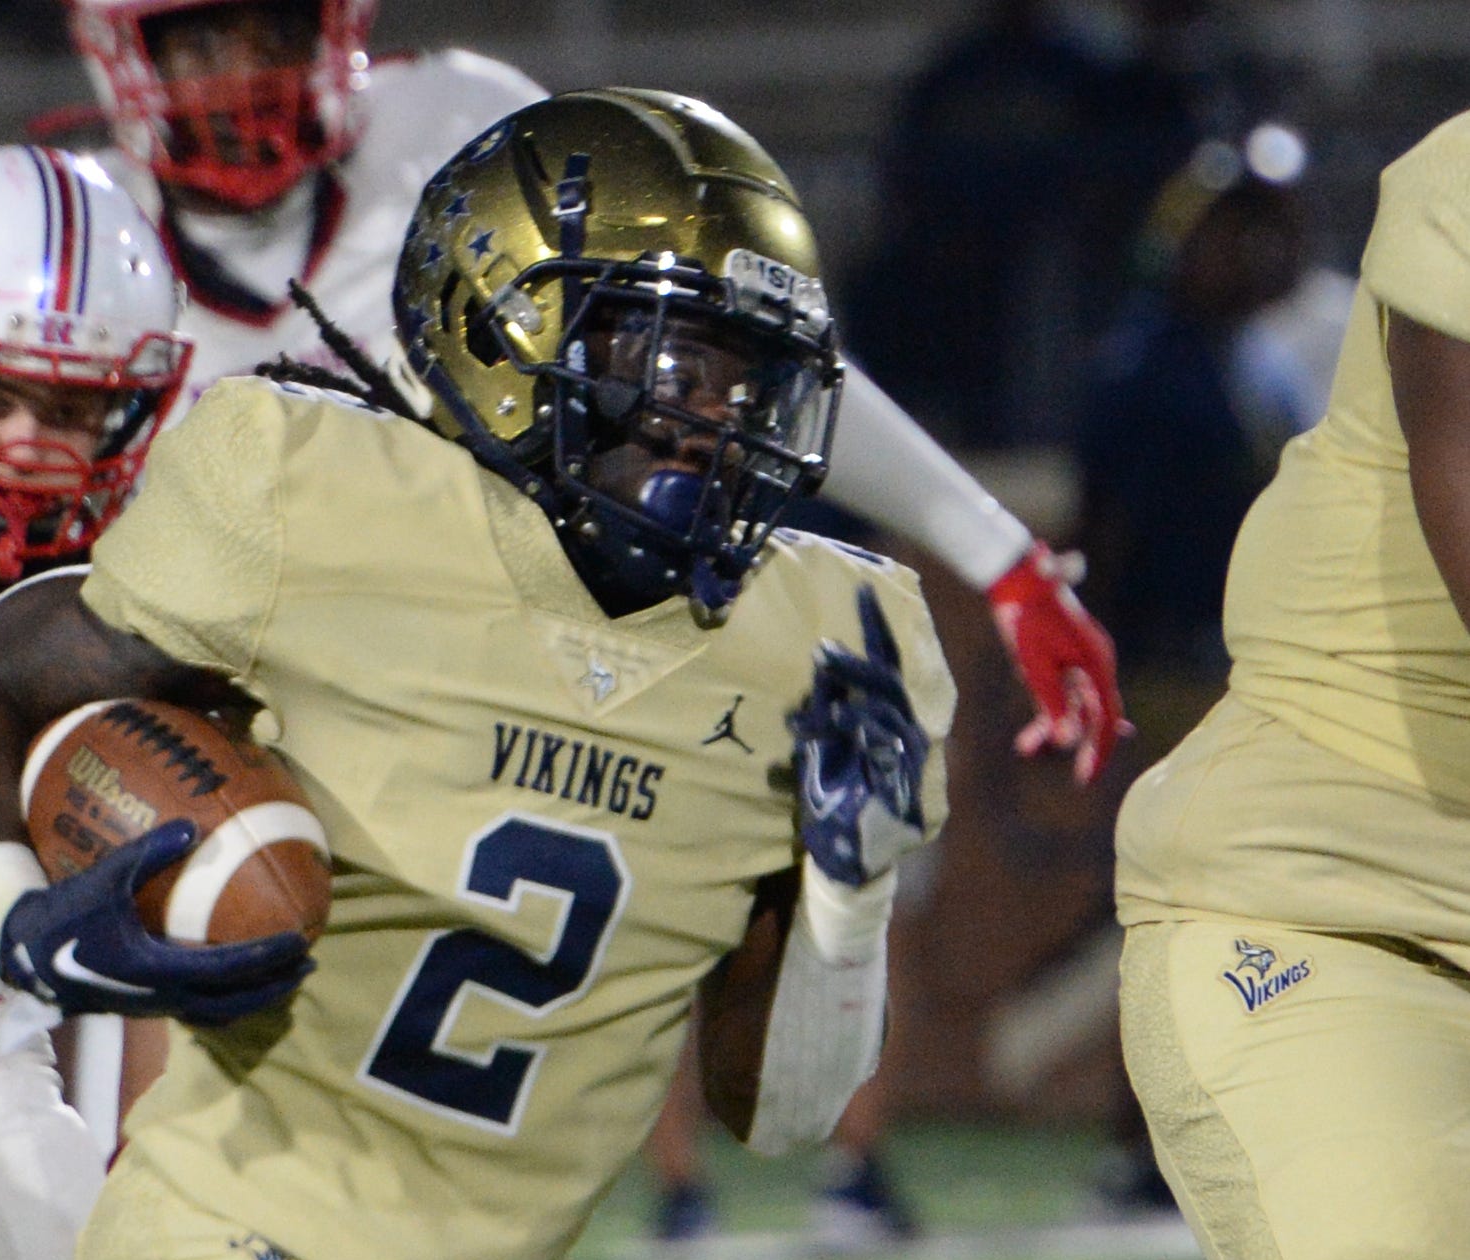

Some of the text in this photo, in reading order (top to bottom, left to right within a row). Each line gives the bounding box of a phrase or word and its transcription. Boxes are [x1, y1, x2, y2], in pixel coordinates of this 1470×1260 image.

[490, 721, 666, 821] VIKINGS
[355, 808, 634, 1138] 2
[1223, 960, 1311, 1012] VIKINGS
